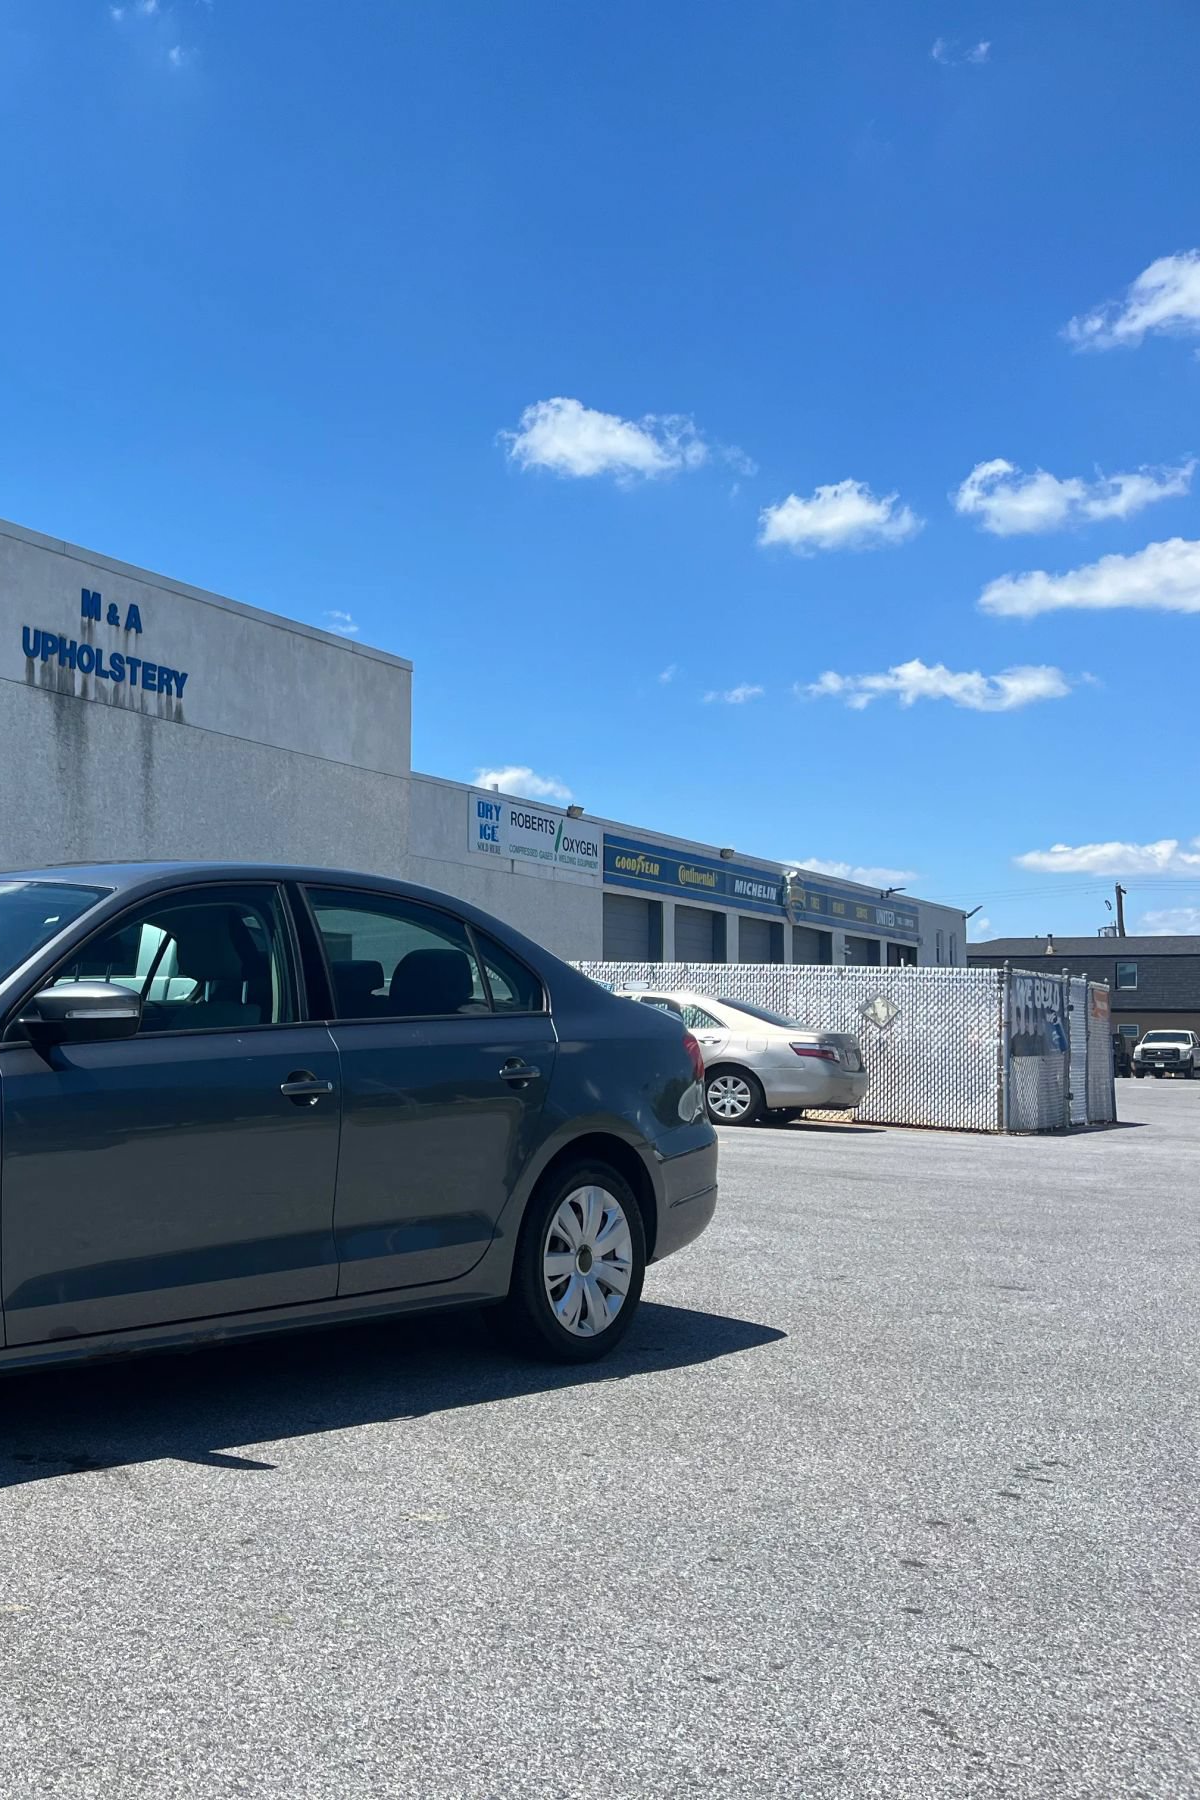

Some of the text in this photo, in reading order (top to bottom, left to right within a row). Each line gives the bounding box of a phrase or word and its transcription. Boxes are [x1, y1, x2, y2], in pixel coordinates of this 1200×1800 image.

[81, 588, 143, 634] M & A
[22, 625, 189, 699] UPHOLSTERY
[477, 800, 502, 822] DRY
[479, 823, 499, 843] ICE
[510, 810, 555, 836] ROBERTS
[562, 836, 598, 858] OXYGEN
[615, 855, 660, 876] GOODYEAR
[734, 879, 777, 901] MICHELIN
[876, 908, 894, 927] UNITED
